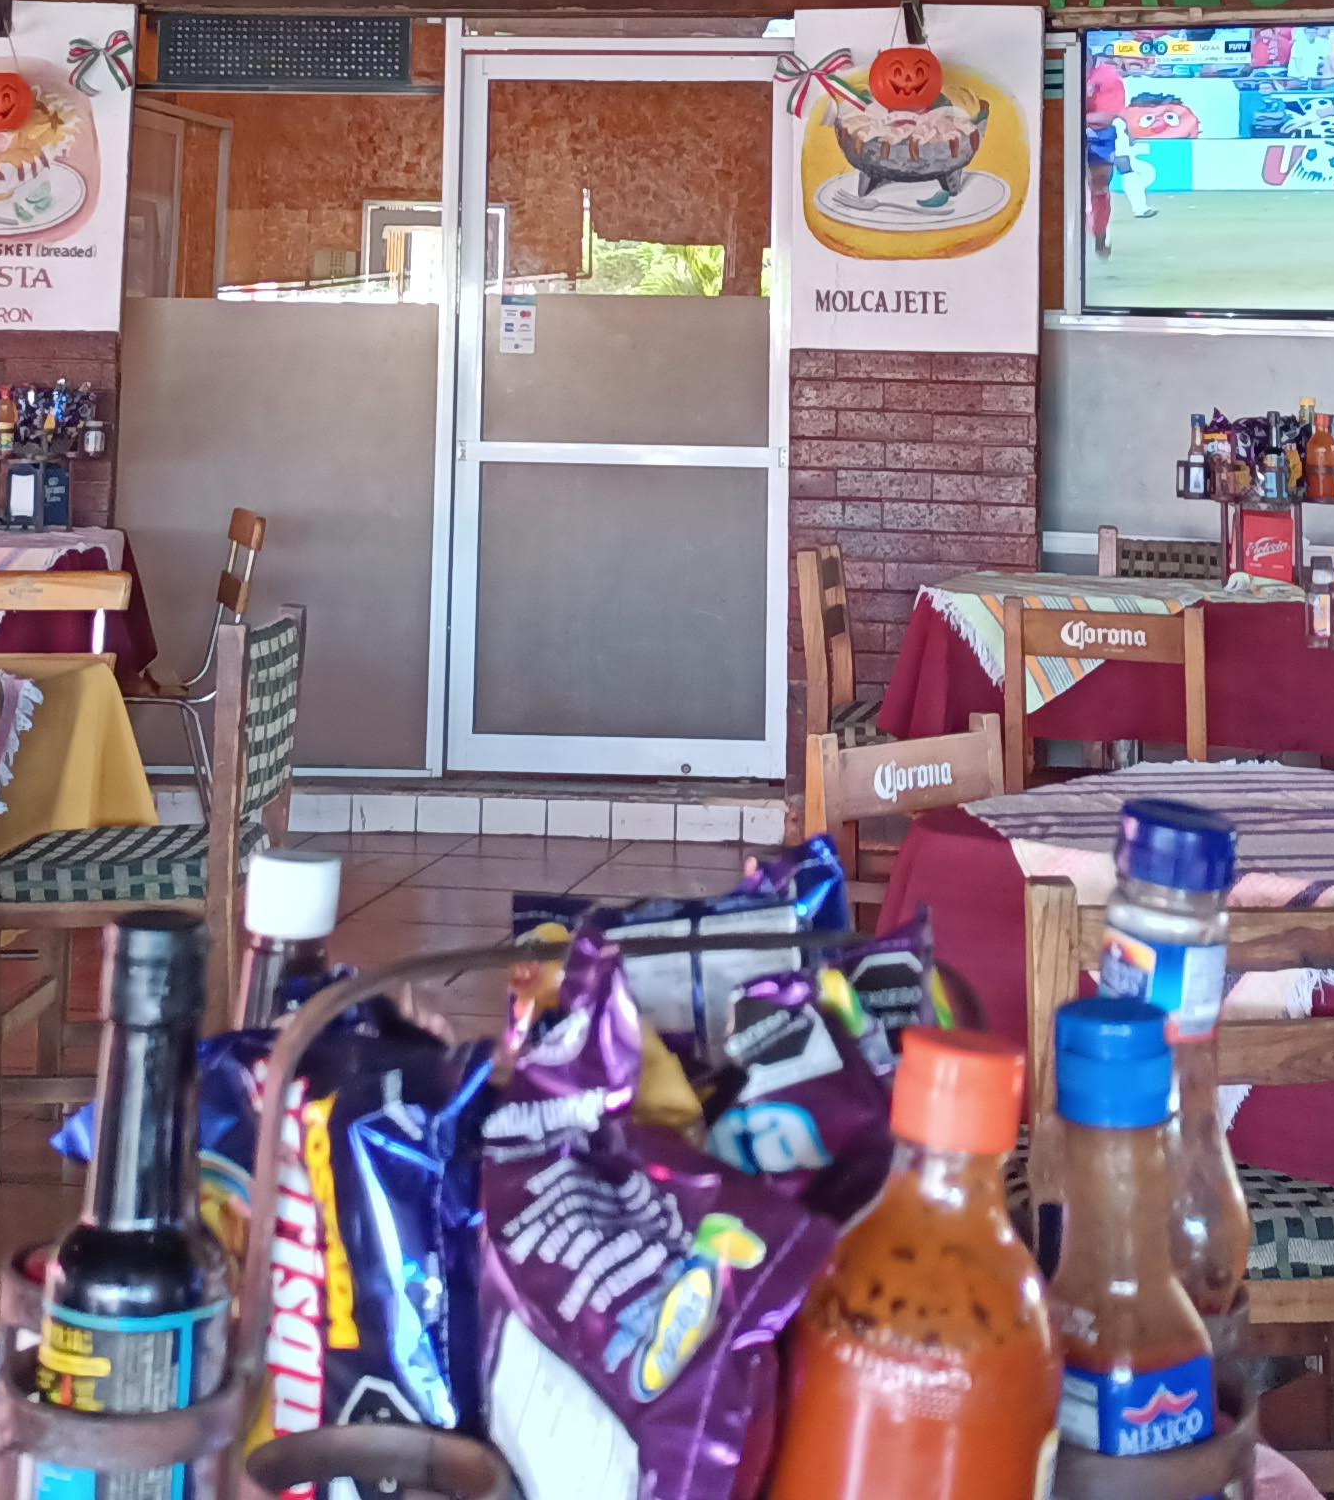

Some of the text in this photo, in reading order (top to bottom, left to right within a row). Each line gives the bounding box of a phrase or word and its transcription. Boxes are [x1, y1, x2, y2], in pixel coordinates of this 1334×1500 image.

[35, 243, 98, 259] (breaded)
[815, 288, 949, 315] MOLCAJETE
[1061, 619, 1147, 650] Corona
[873, 759, 953, 803] Corona
